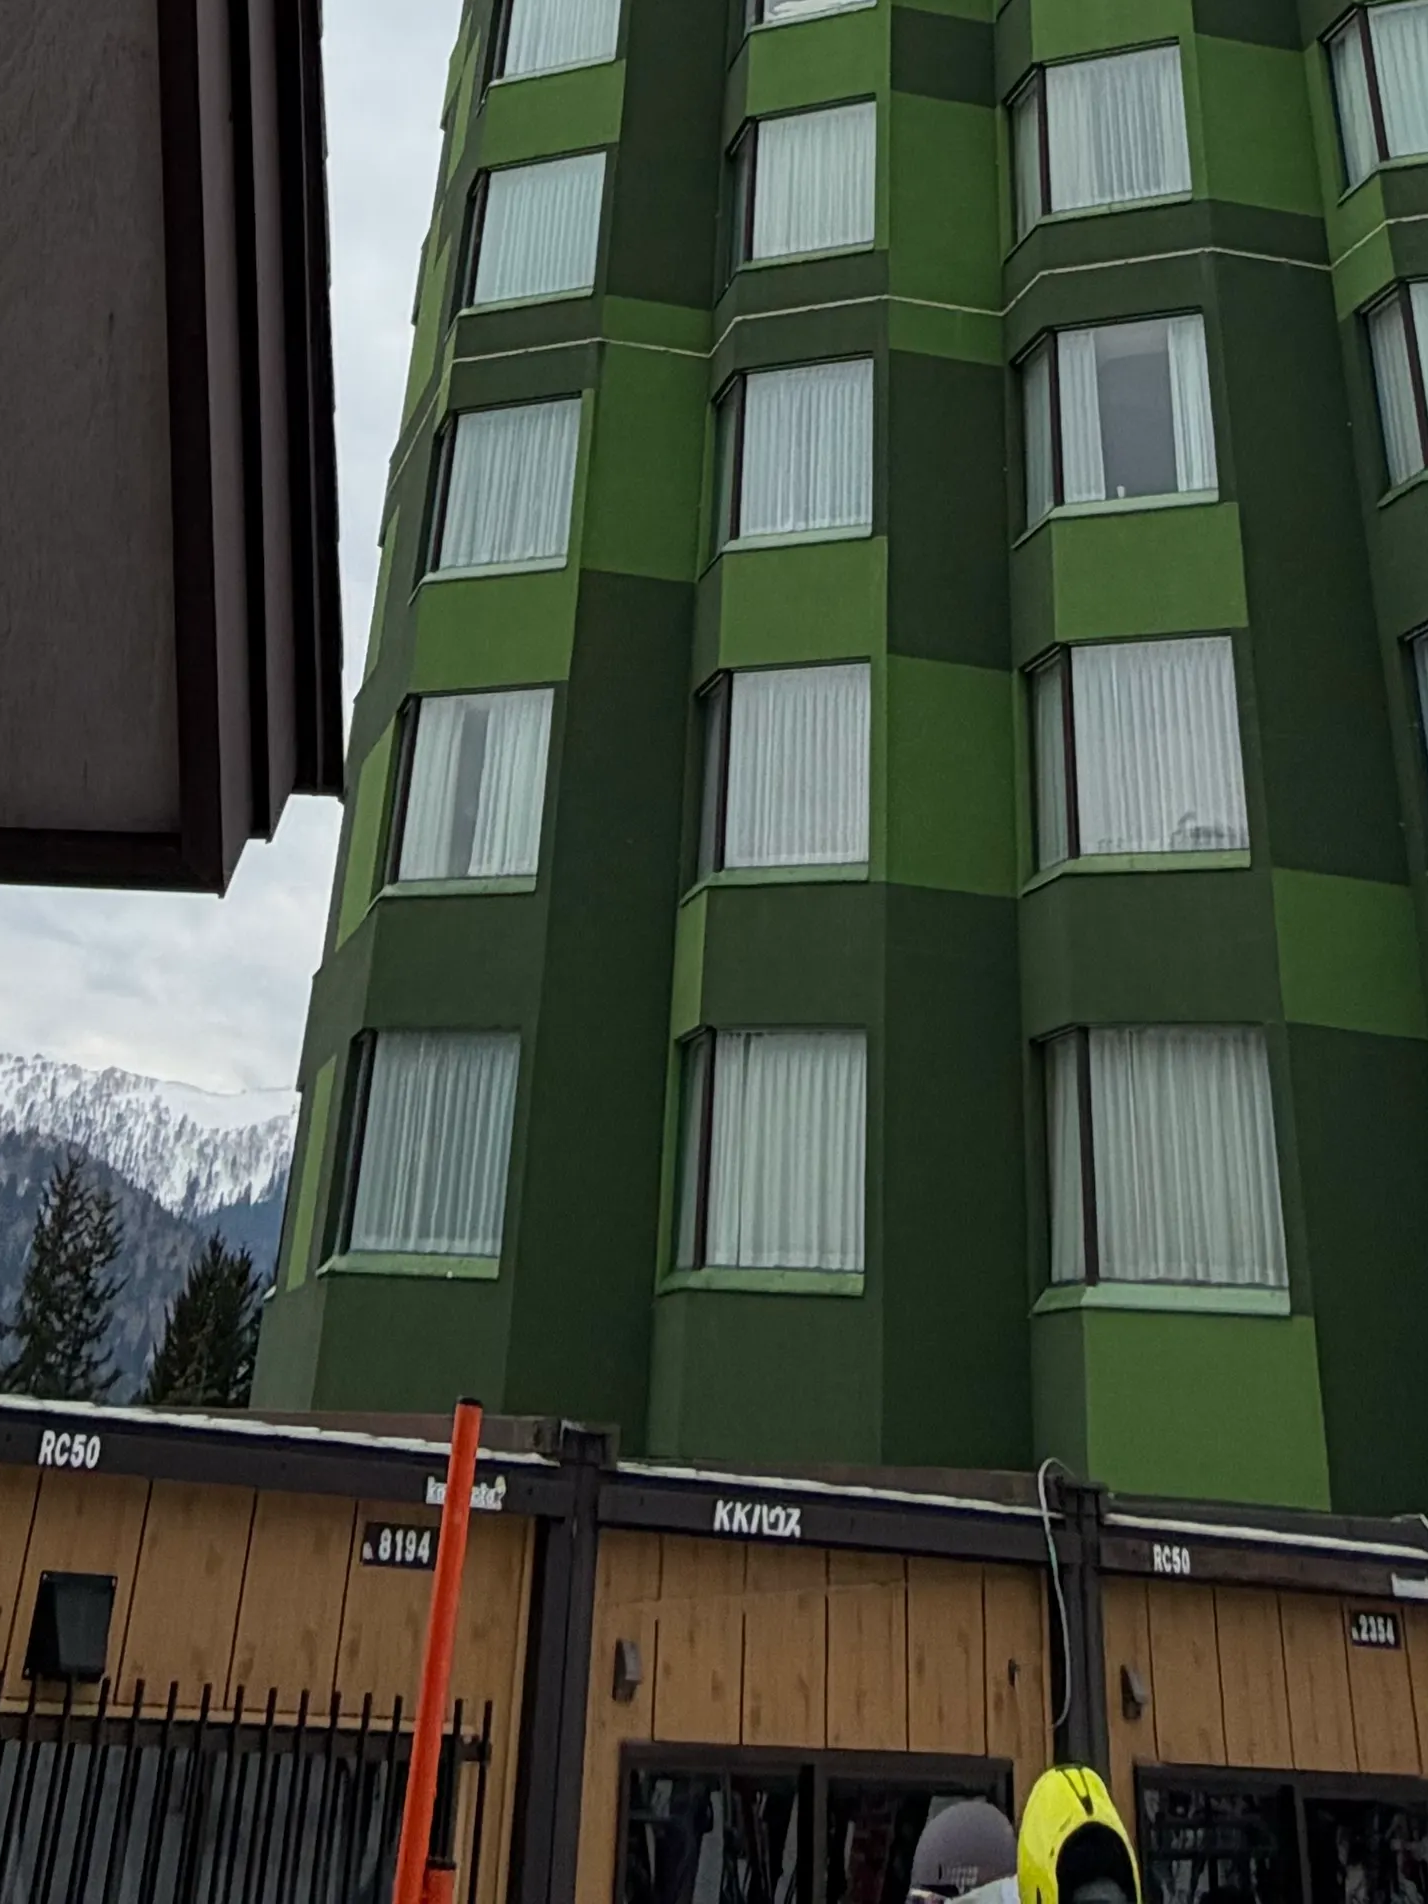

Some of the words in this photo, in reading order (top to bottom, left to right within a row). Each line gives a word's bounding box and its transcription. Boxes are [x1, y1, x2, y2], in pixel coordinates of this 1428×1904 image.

[37, 1429, 101, 1469] RC50
[378, 1528, 432, 1564] 8194
[1153, 1543, 1191, 1574] RC50
